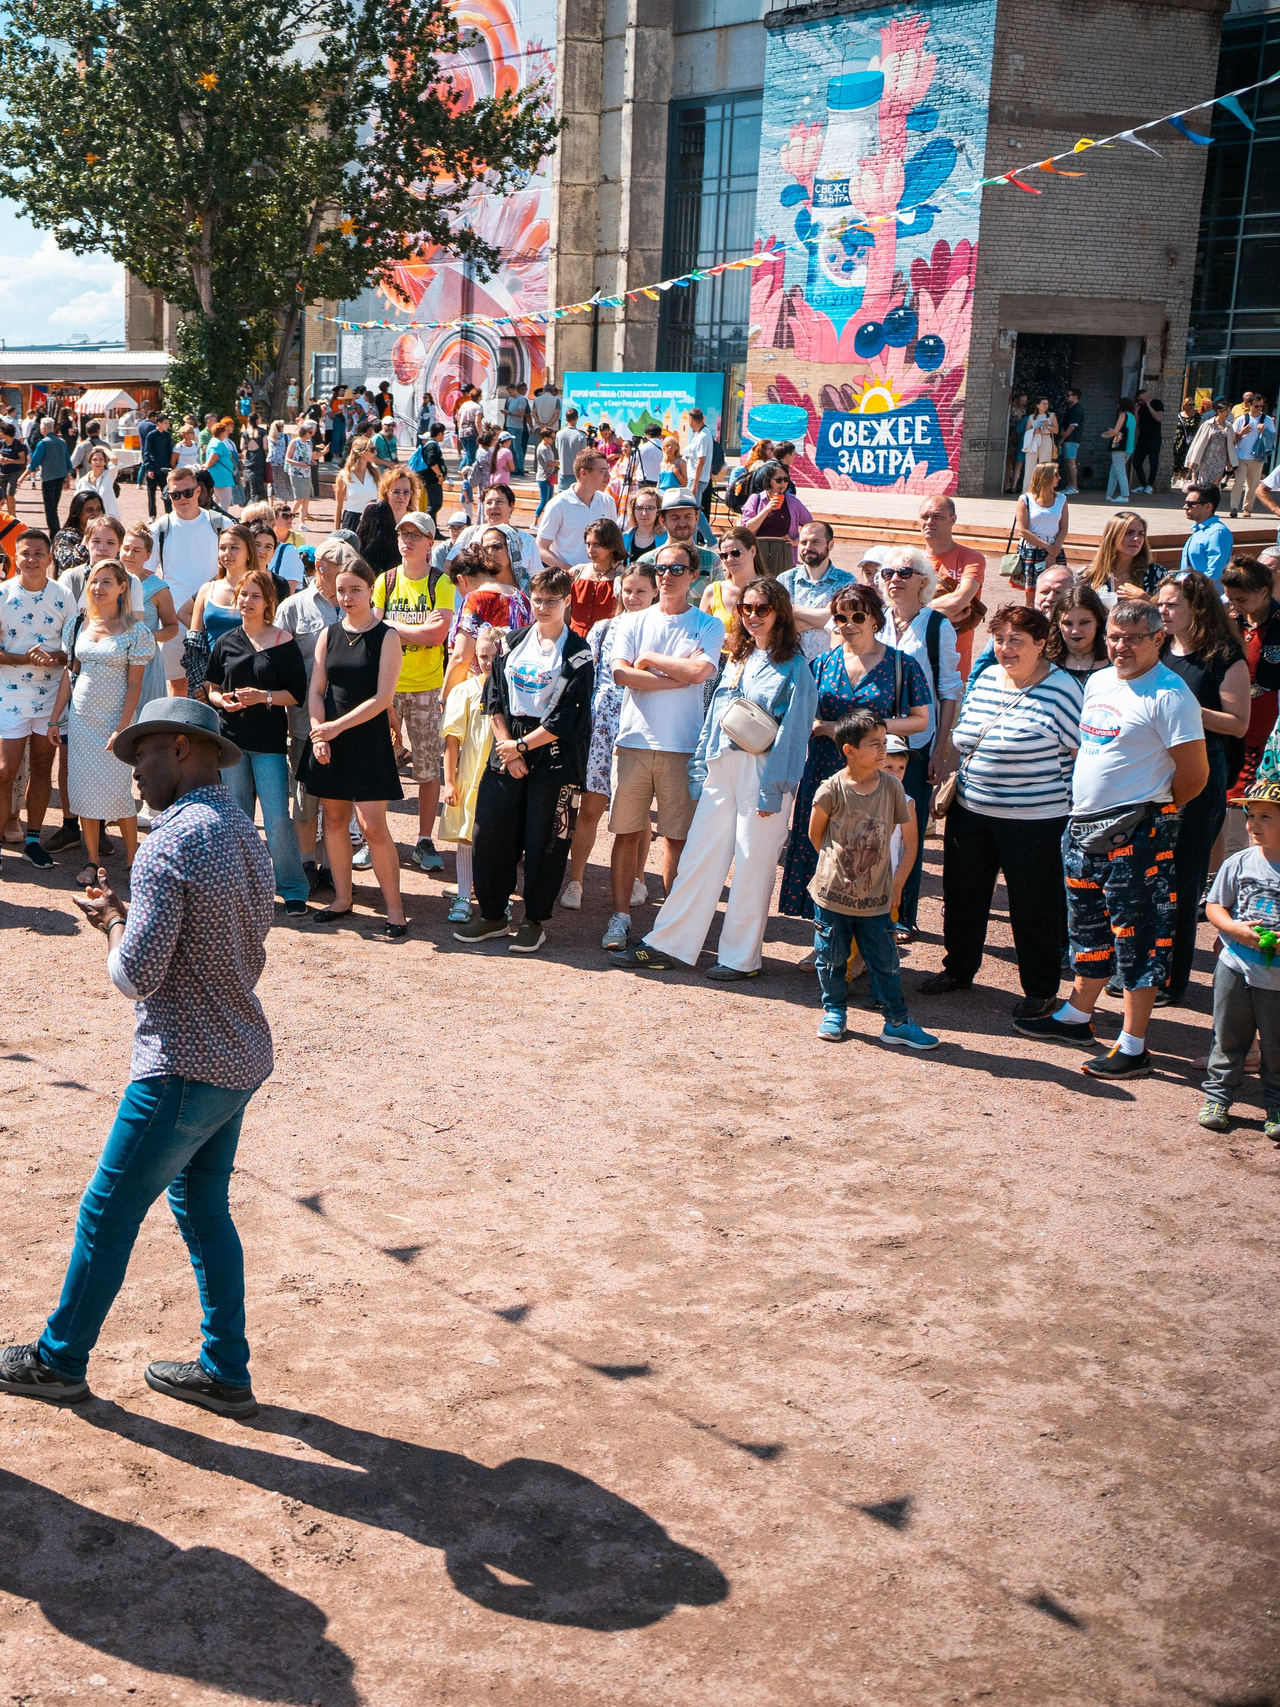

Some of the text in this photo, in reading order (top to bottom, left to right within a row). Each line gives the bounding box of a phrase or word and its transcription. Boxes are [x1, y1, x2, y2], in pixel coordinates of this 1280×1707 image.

[817, 193, 850, 204] ЗАВТРА
[570, 389, 589, 398] ВТОРОЙ
[589, 390, 616, 398] ФЕСТИВАЛЬ
[617, 390, 633, 398] СТРАН
[633, 389, 661, 398] ЛАТИНСКОЙ
[828, 415, 932, 448] СВЕЖЕЕ
[837, 446, 917, 475] ЗАВТРА
[391, 603, 428, 611] KEEP IT
[635, 950, 650, 961] N
